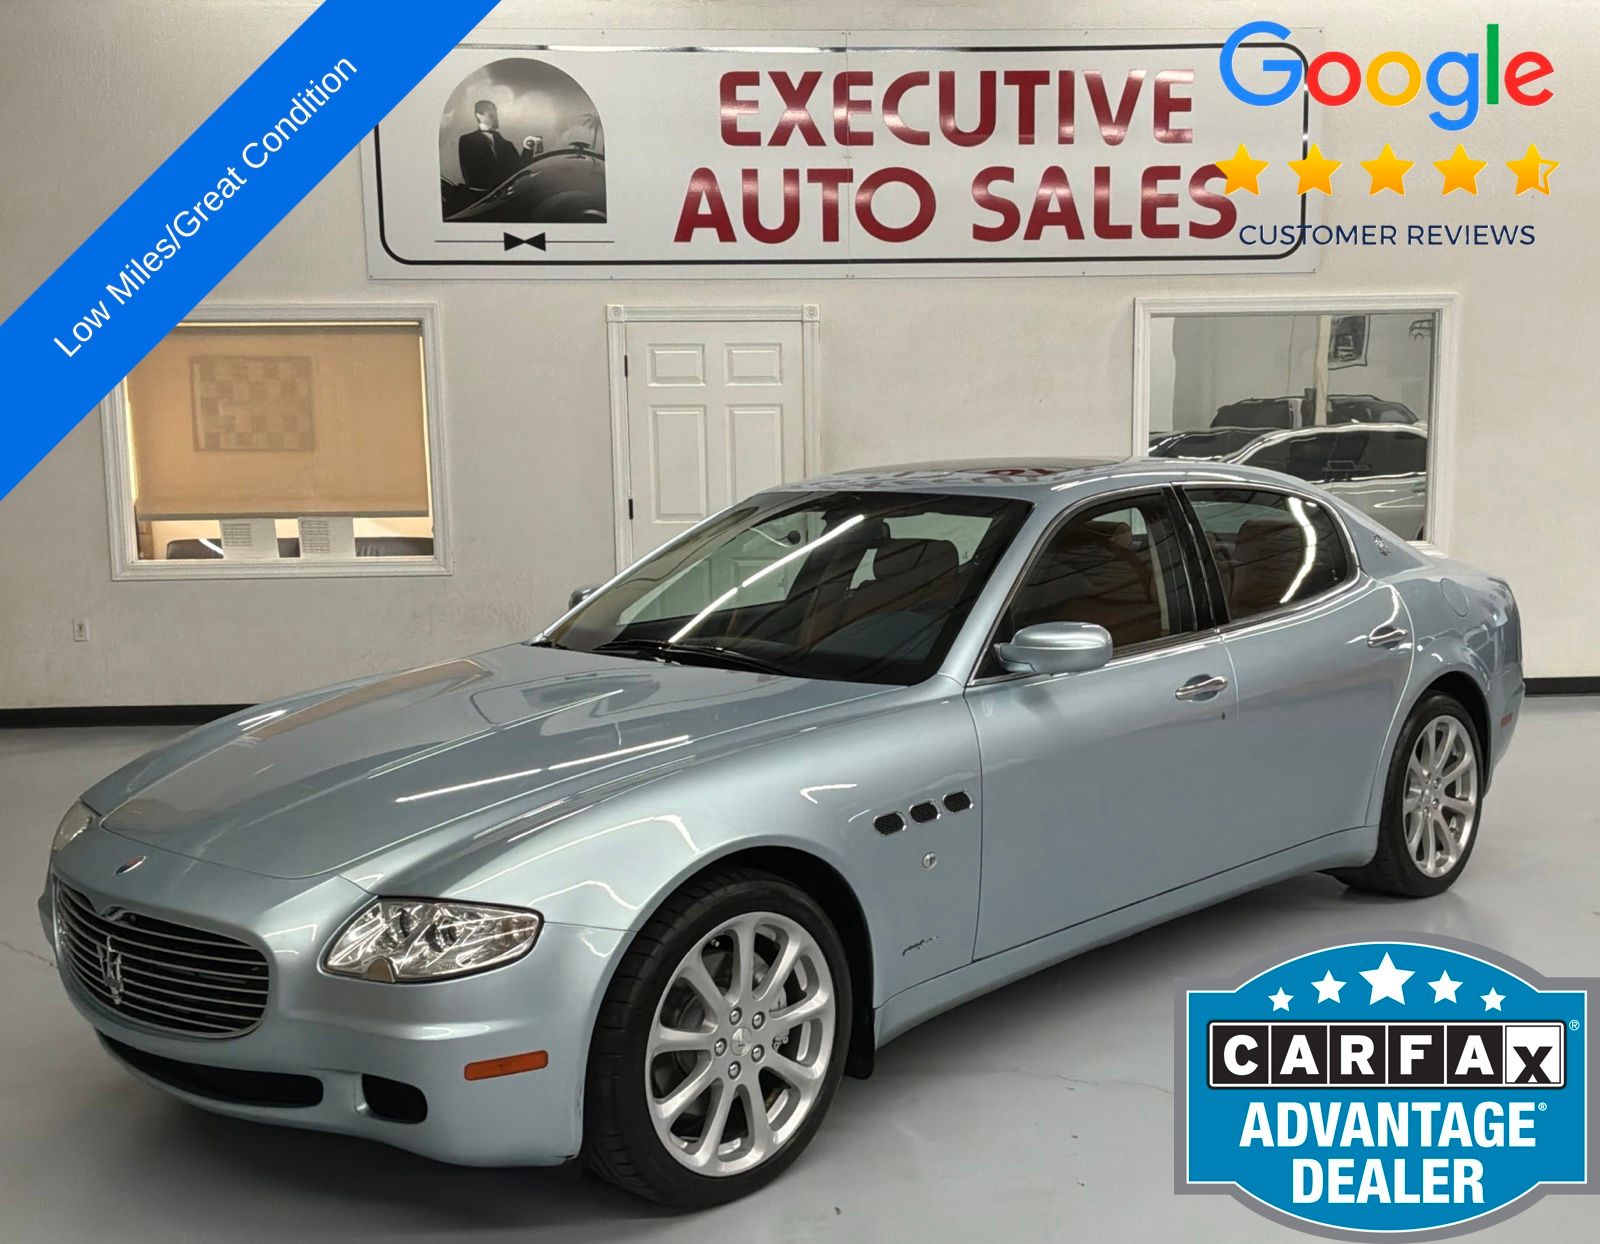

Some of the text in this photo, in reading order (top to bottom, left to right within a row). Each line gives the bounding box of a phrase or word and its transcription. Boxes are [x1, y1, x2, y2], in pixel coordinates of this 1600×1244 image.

[719, 69, 1194, 148] EXECUTIVE
[673, 164, 1238, 246] AUTO SALES
